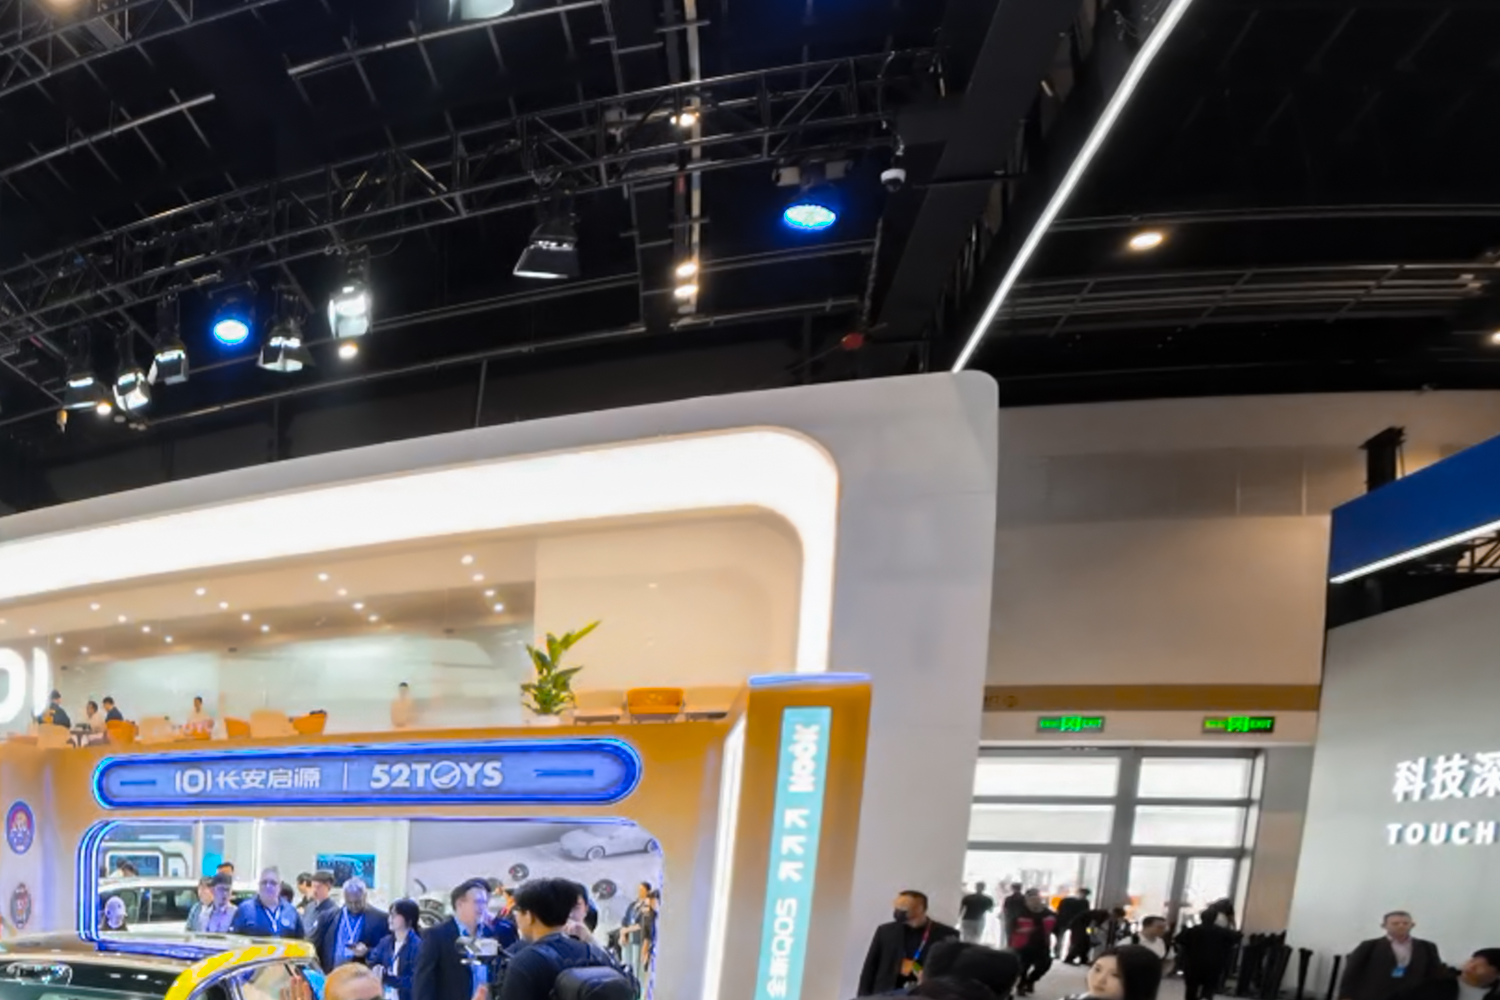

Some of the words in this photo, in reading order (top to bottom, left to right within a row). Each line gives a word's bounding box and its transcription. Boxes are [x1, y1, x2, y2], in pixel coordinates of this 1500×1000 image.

[216, 766, 321, 790] 长安启源
[370, 760, 503, 789] 52TOYS
[1387, 821, 1495, 845] TOUCH
